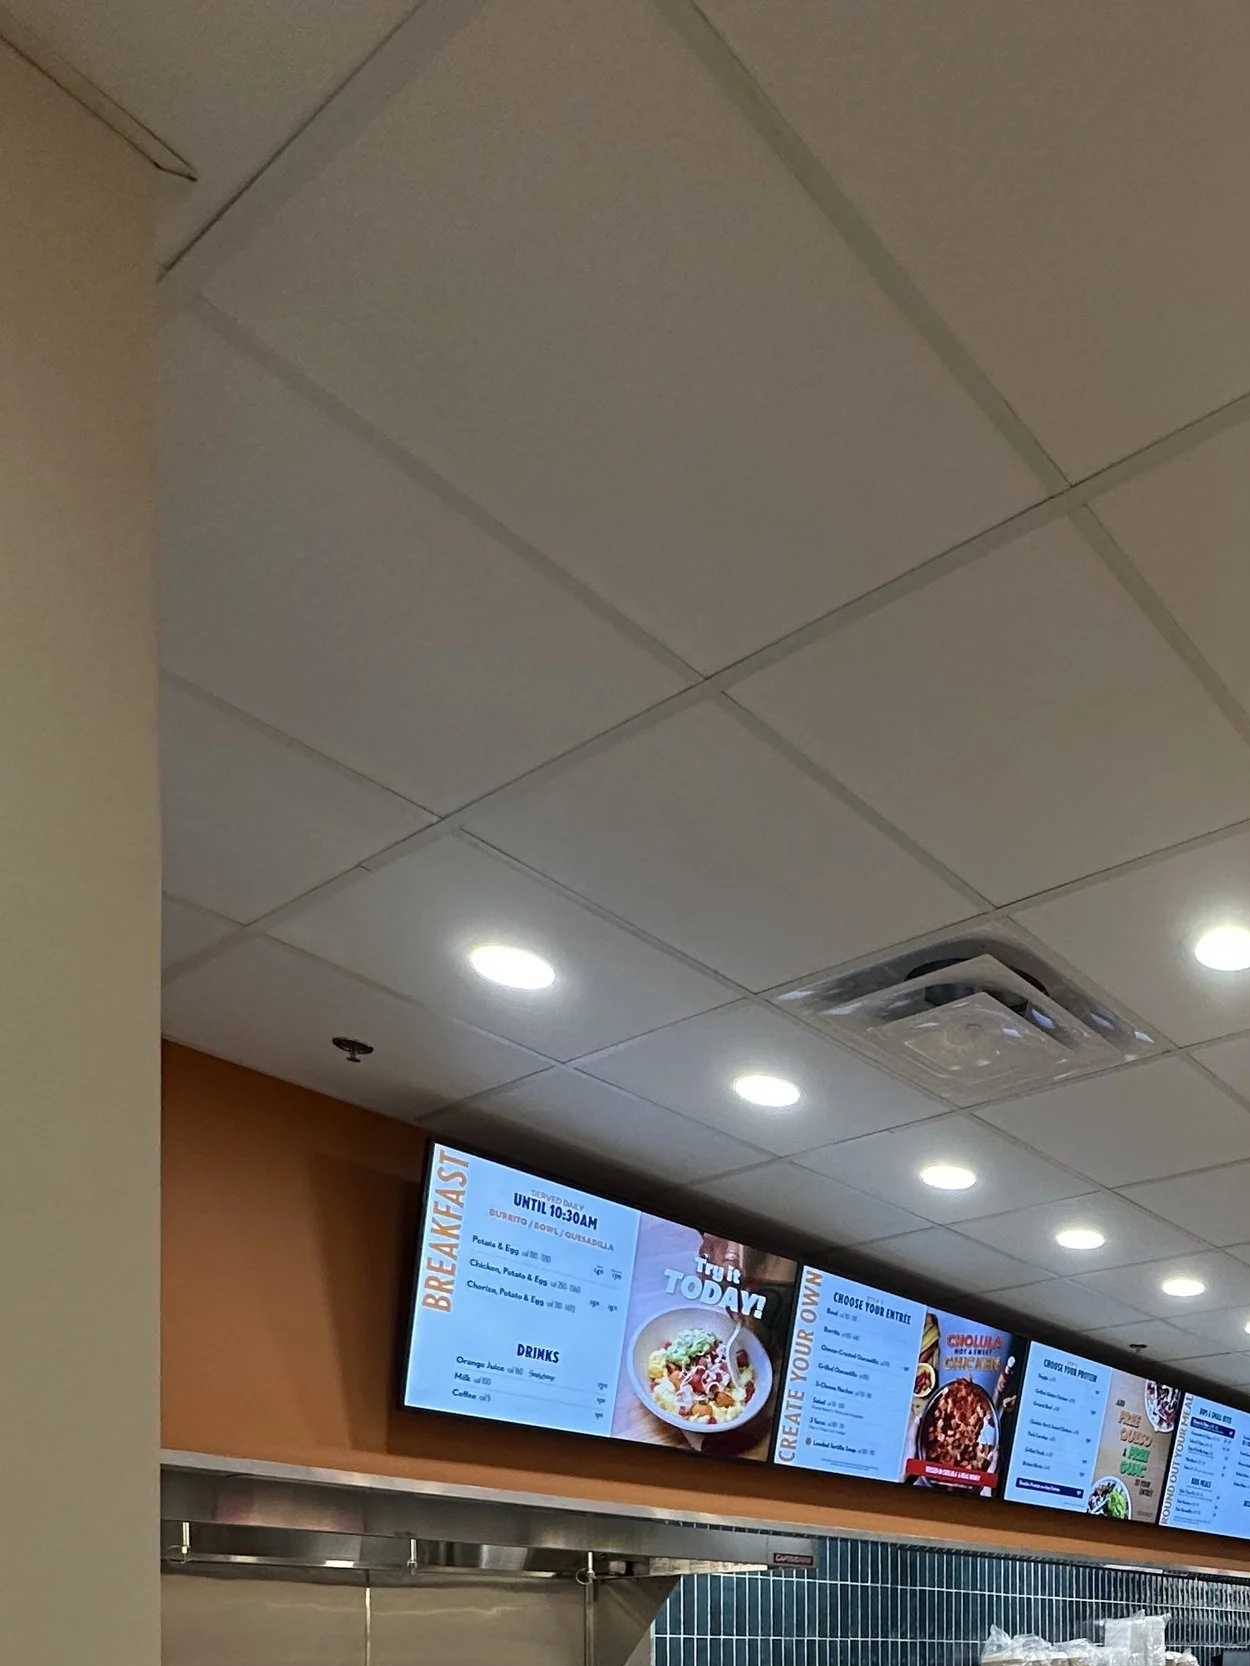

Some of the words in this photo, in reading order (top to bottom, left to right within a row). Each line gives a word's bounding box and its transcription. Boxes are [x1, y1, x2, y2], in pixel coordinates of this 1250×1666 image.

[513, 1192, 547, 1215] UNTIL
[550, 1204, 597, 1230] 10:30AM
[421, 1149, 469, 1312] BREAKFAST
[489, 1207, 527, 1226] BURRITO
[534, 1221, 560, 1236] BOWL
[564, 1231, 614, 1251] QUESADILLA
[472, 1235, 496, 1248] Potato
[498, 1241, 504, 1250] &
[505, 1244, 520, 1256] Egg
[469, 1258, 501, 1275] Chicken,
[503, 1267, 526, 1280] Potato
[527, 1272, 533, 1283] &
[534, 1275, 548, 1287] Egg
[695, 1256, 724, 1282] Try
[726, 1264, 741, 1284] it
[499, 1287, 523, 1300] Potato
[523, 1294, 529, 1302] &
[531, 1295, 544, 1306] Egg
[664, 1268, 767, 1319] TODAY!
[800, 1270, 824, 1324] OWN
[833, 1292, 864, 1311] CHOOSE
[865, 1302, 885, 1317] YOUR
[517, 1343, 560, 1363] DRINKS
[790, 1328, 815, 1383] YOUR
[947, 1334, 1003, 1349] CHOLULA
[454, 1372, 471, 1382] Milk
[456, 1356, 485, 1368] Orange
[486, 1361, 505, 1372] Juice
[944, 1356, 1000, 1371] CHICKEN
[452, 1388, 477, 1400] Coffee
[1181, 1395, 1194, 1427] MEAL
[778, 1388, 805, 1463] CREATE
[1174, 1427, 1187, 1459] YOUR
[1169, 1460, 1180, 1485] OUT
[1160, 1485, 1176, 1525] ROUND
